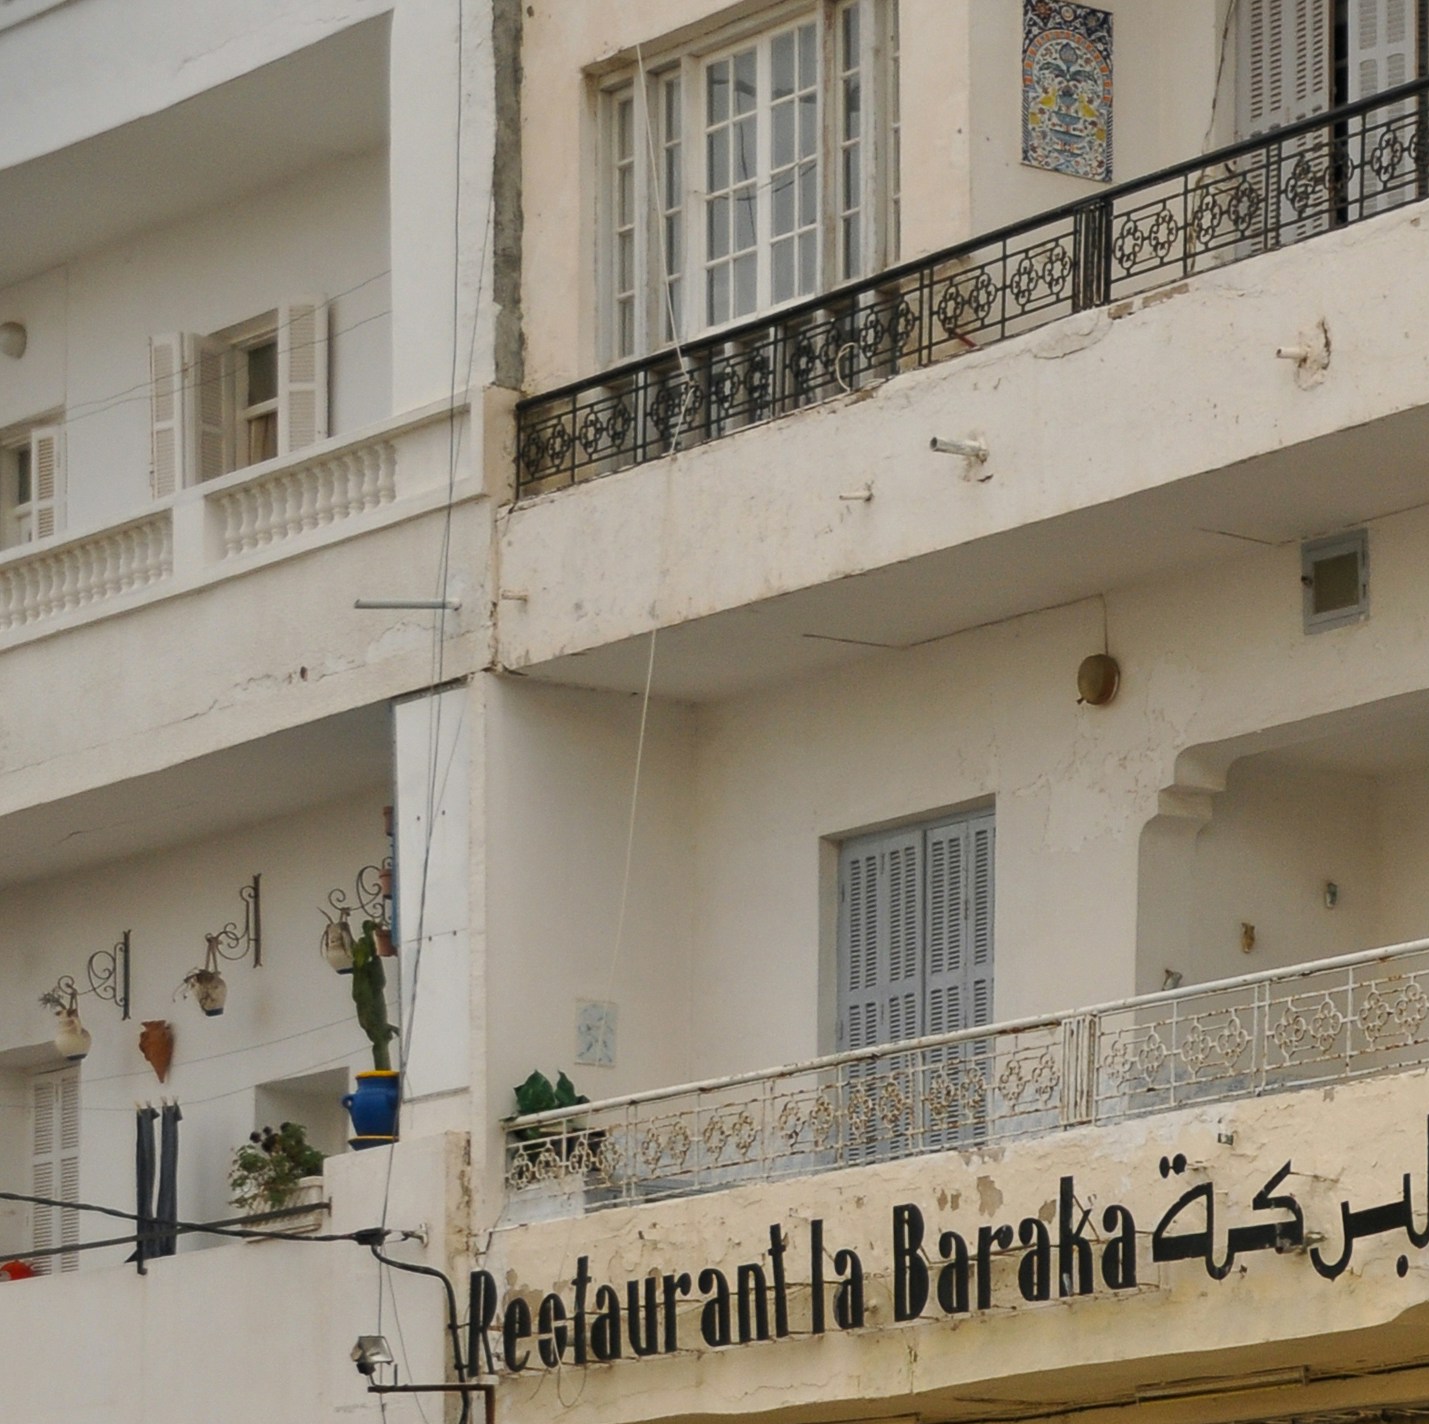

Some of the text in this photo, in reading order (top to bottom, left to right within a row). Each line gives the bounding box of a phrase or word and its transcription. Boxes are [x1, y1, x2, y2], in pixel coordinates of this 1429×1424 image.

[468, 1175, 1137, 1377] Restaurant la Baraka
